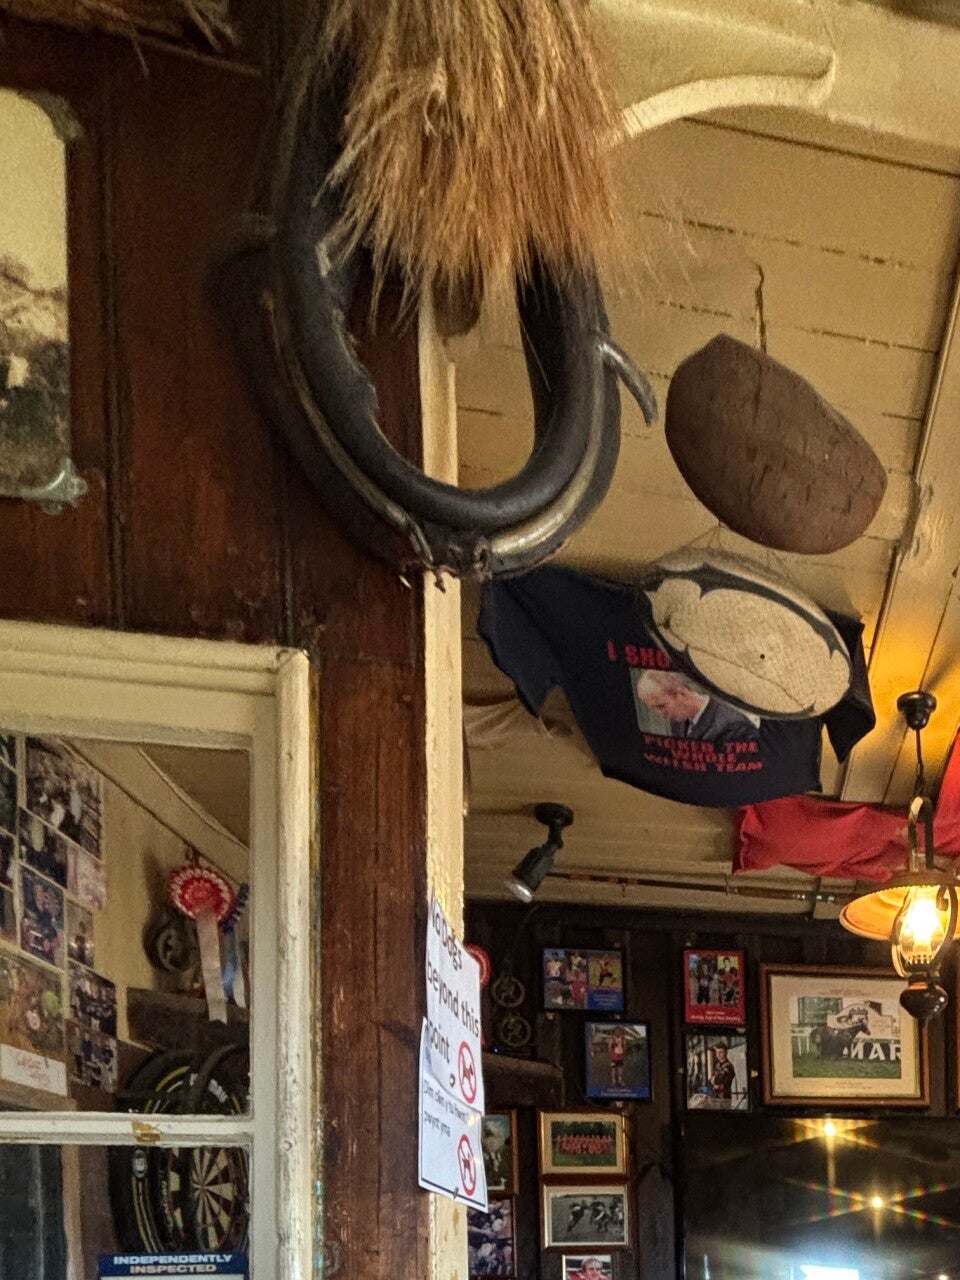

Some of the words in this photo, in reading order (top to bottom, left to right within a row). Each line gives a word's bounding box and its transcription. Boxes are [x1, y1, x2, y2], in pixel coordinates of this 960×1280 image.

[426, 951, 460, 1019] beyond
[461, 999, 480, 1039] this
[428, 1022, 450, 1064] point
[113, 1254, 232, 1265] INDEPENDENTLY
[129, 1264, 217, 1274] INSPECTED
